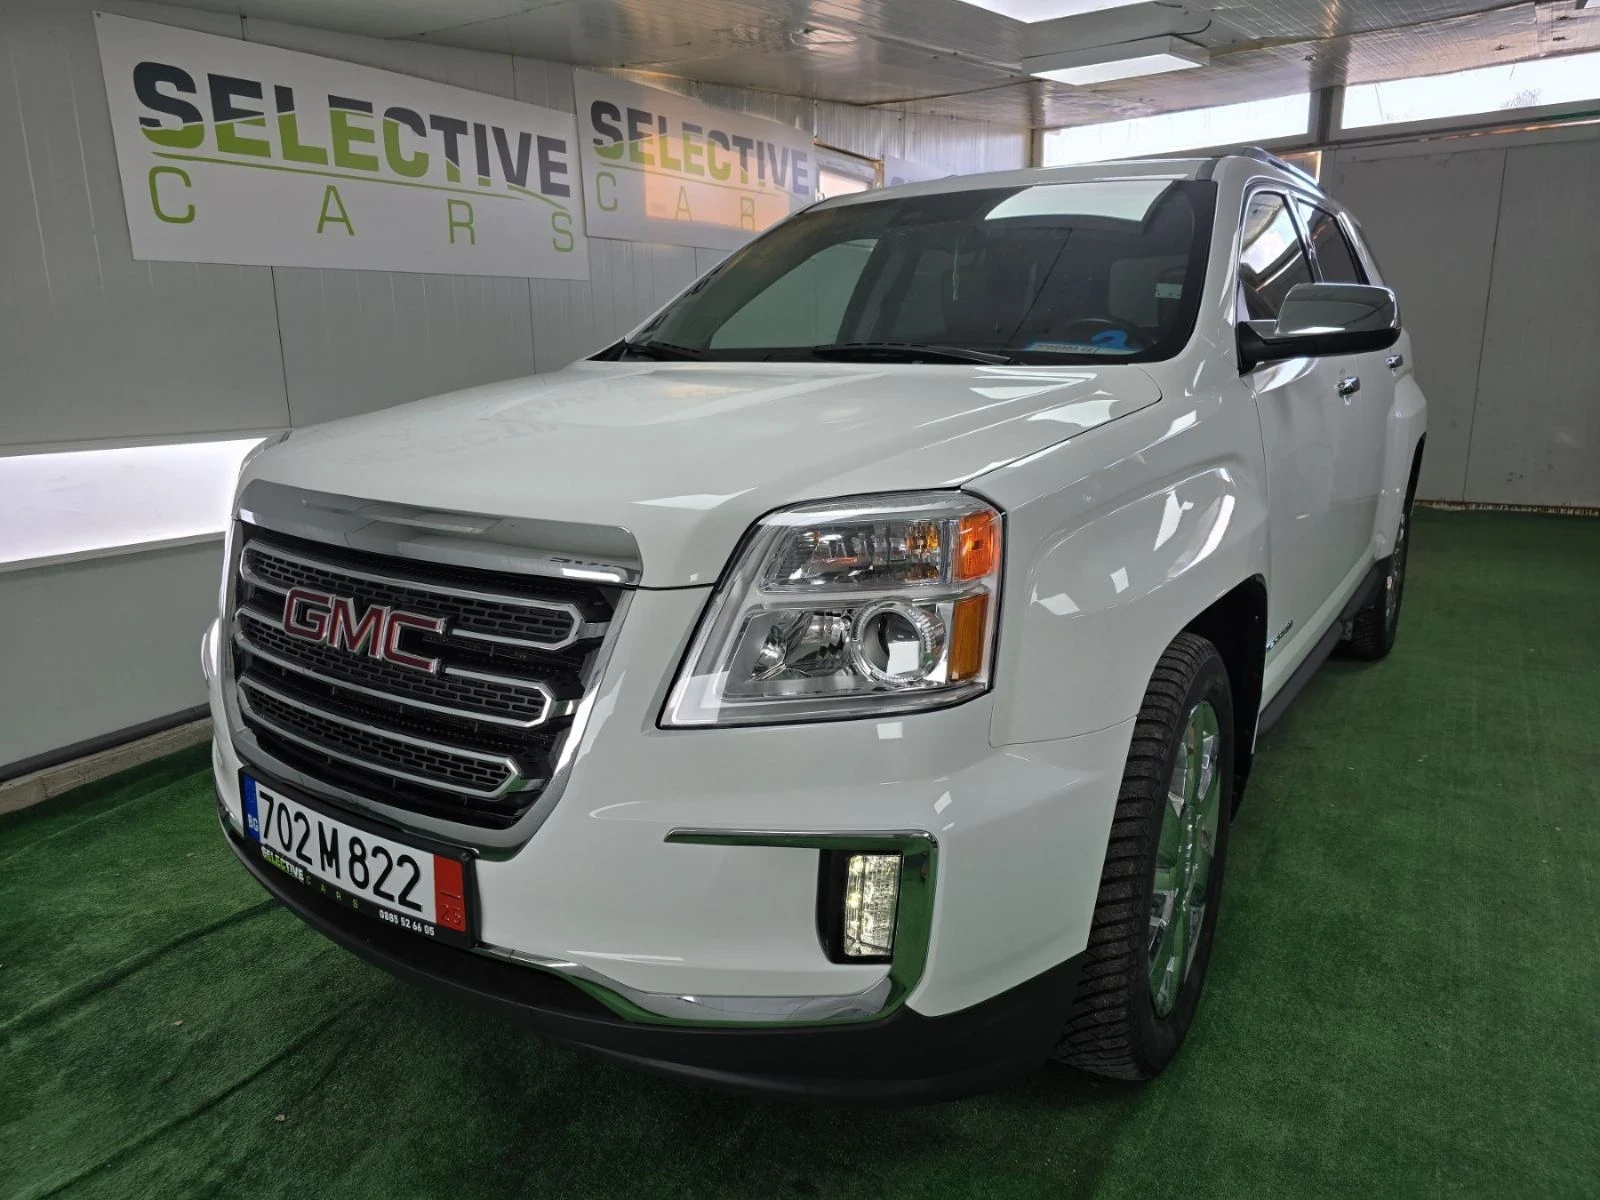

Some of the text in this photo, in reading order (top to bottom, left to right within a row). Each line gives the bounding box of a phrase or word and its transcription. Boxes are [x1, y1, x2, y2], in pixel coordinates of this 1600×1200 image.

[133, 61, 571, 198] SELECTIVE
[590, 100, 810, 196] SELECTIVE
[148, 165, 574, 253] CARS
[596, 171, 757, 232] CAR
[283, 587, 447, 675] GMC
[247, 813, 259, 832] BG
[261, 845, 305, 885] SELECTIVE
[379, 909, 435, 936] 0885 52 66 05
